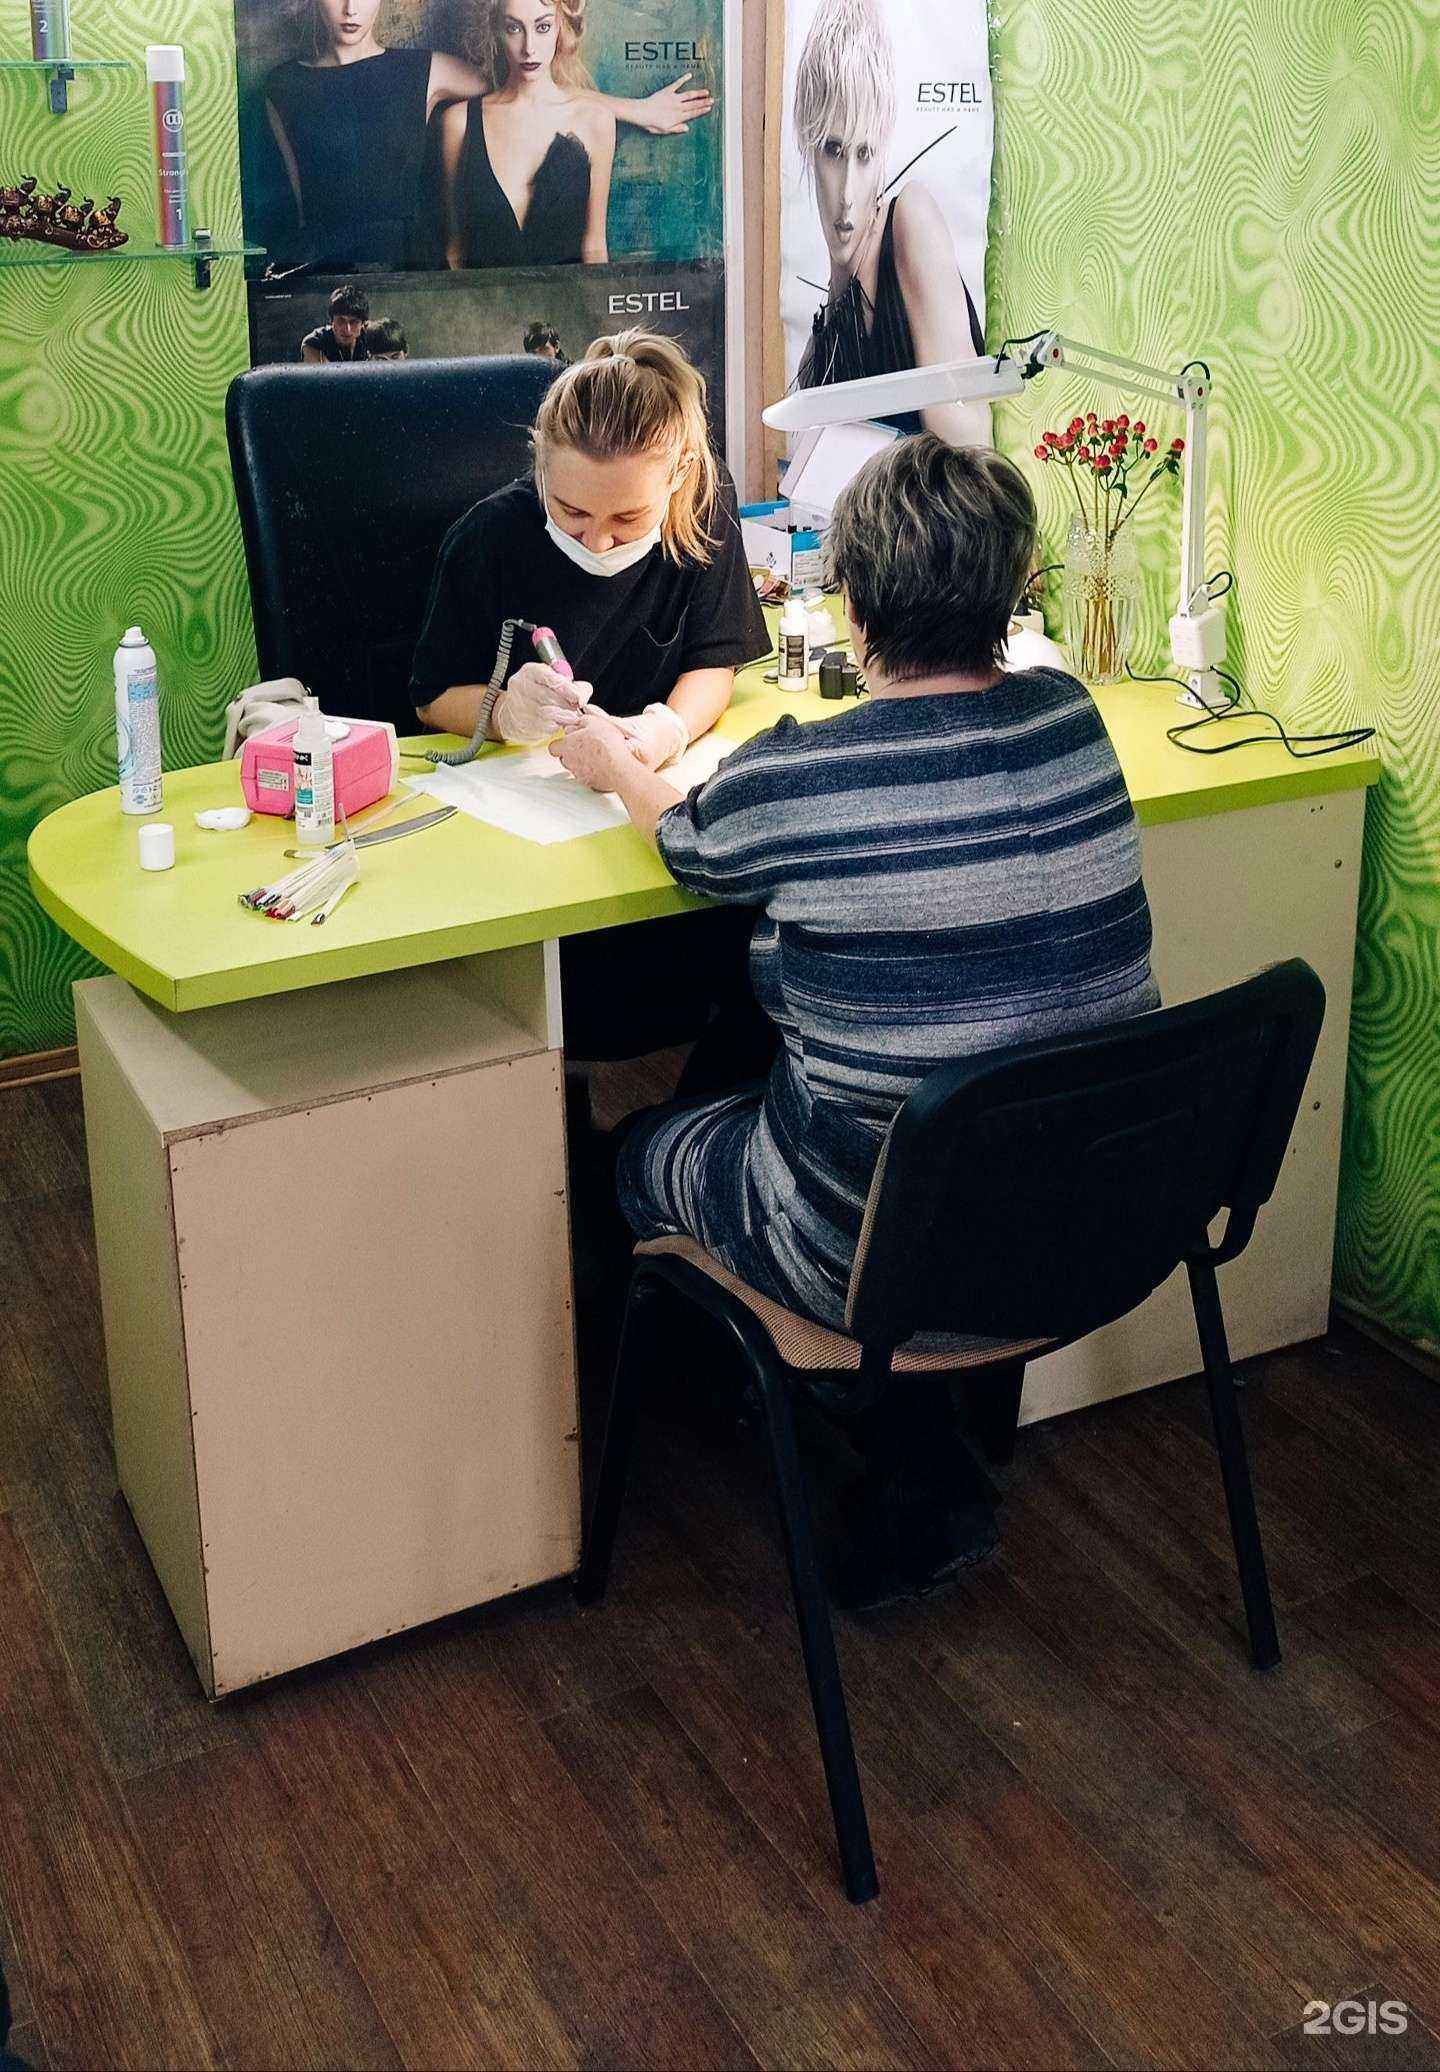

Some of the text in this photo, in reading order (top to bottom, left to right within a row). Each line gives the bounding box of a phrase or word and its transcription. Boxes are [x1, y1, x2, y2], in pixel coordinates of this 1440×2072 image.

[40, 20, 48, 32] 2
[625, 42, 705, 61] ESTEL
[918, 83, 982, 103] ESTEL
[176, 208, 183, 220] 1
[608, 291, 690, 314] ESTEL
